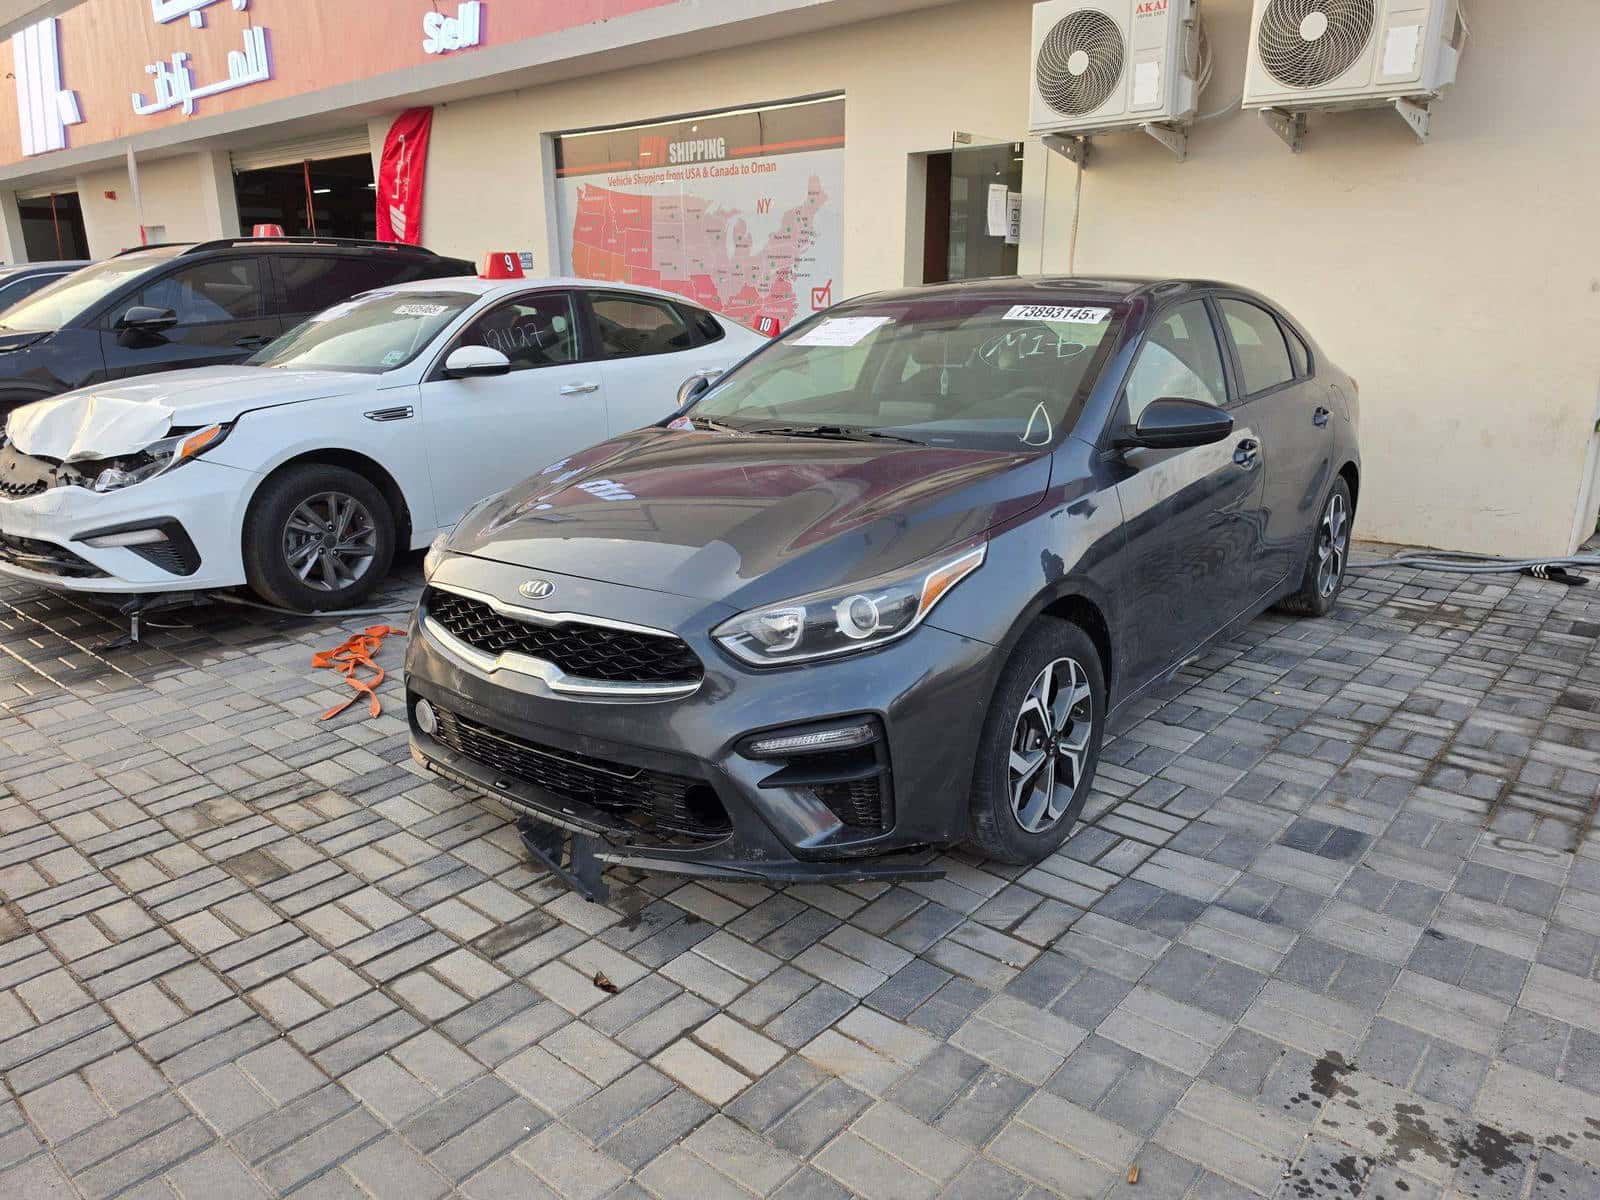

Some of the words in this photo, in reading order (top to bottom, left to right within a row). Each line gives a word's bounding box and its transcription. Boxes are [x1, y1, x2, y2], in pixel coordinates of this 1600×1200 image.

[1136, 0, 1167, 14] AKAI
[423, 1, 481, 54] Sell
[669, 137, 725, 163] SHIPPING
[608, 174, 632, 187] Vehicle
[633, 172, 664, 186] Shipping
[685, 168, 701, 180] USA
[703, 168, 708, 177] &
[710, 164, 739, 177] Canada
[741, 164, 750, 174] to
[752, 161, 777, 173] Oman
[757, 198, 772, 214] NY
[505, 254, 514, 272] 9
[760, 317, 771, 331] 10
